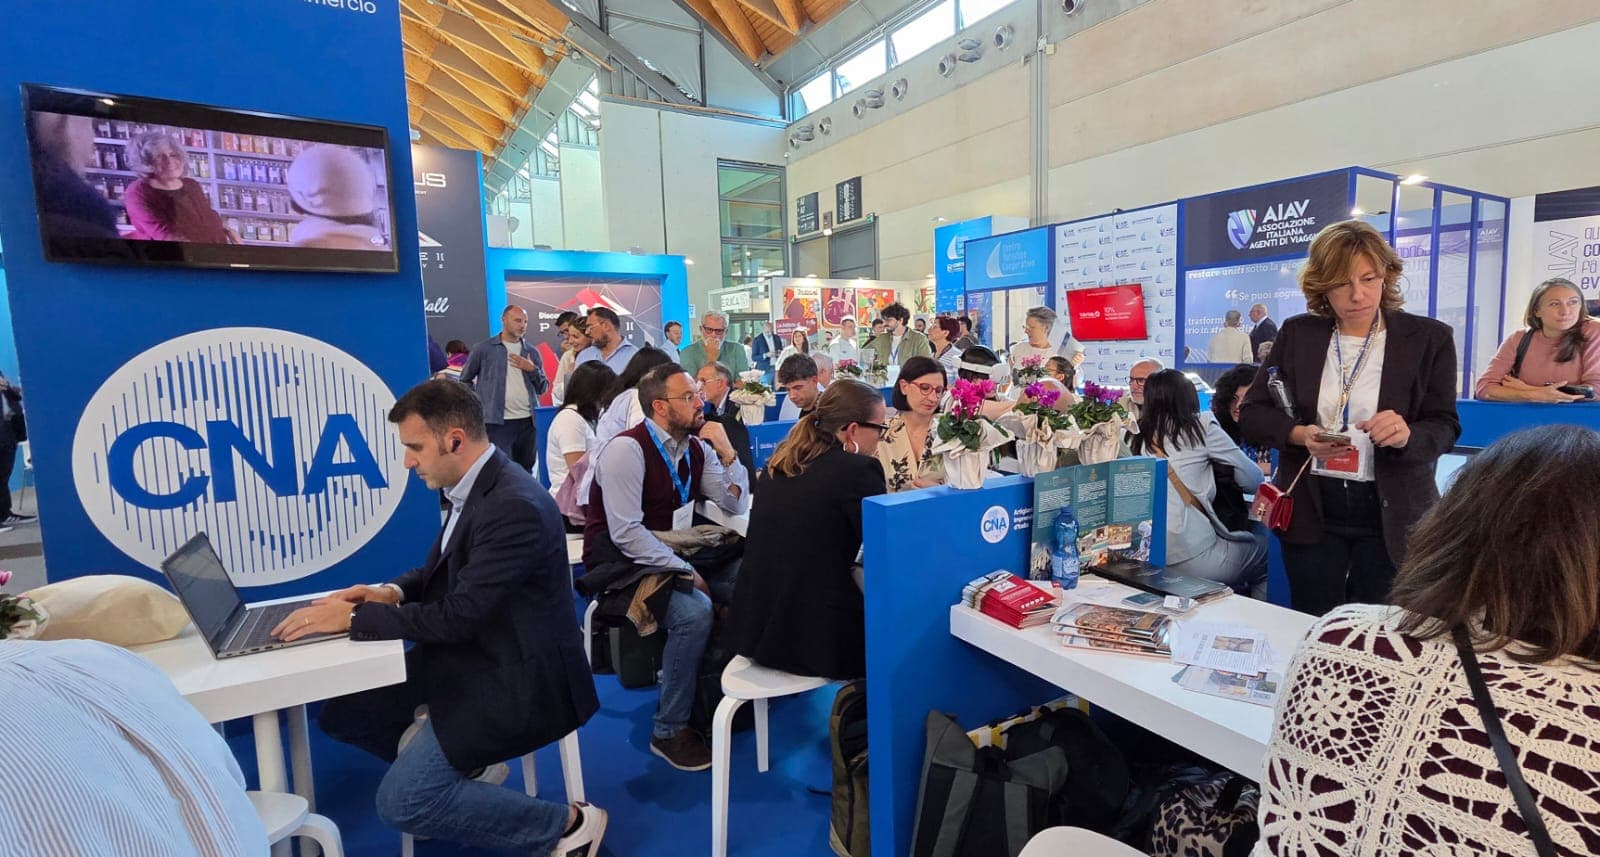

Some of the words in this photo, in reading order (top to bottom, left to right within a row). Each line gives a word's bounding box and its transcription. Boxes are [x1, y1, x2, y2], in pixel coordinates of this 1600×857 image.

[1262, 199, 1311, 223] AIAV
[1256, 216, 1316, 233] ASSOCIAZIONE
[1266, 227, 1304, 239] ITALIANA
[1249, 239, 1278, 250] AGENTI
[1279, 237, 1288, 246] DI
[107, 413, 389, 510] CNA
[983, 517, 1007, 533] CNA
